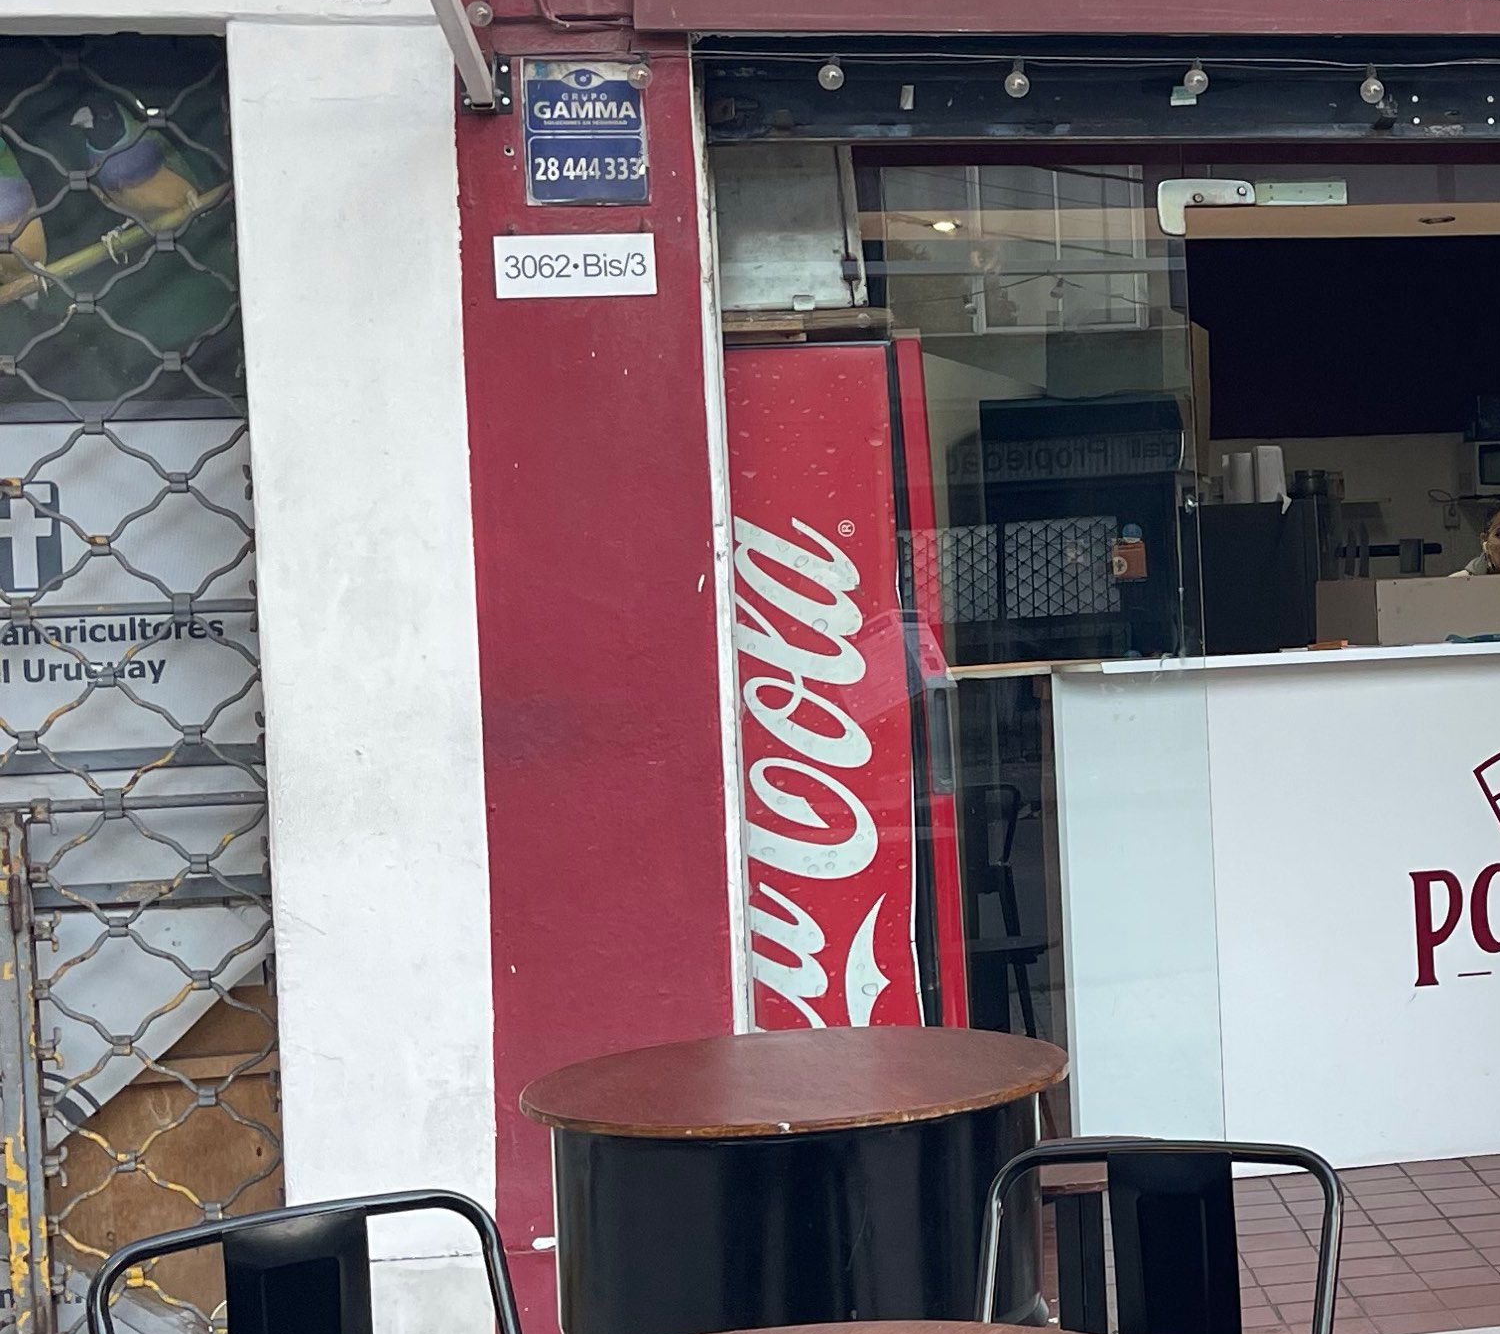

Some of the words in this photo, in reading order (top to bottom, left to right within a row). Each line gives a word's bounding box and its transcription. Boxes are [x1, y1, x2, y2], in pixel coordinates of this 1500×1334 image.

[561, 93, 608, 101] GRUPO
[533, 101, 637, 119] GAMMA
[534, 157, 560, 181] 28
[562, 157, 602, 181] 444
[604, 157, 640, 180] 333
[0, 617, 224, 645] anaricultores
[23, 659, 166, 684] Uruay
